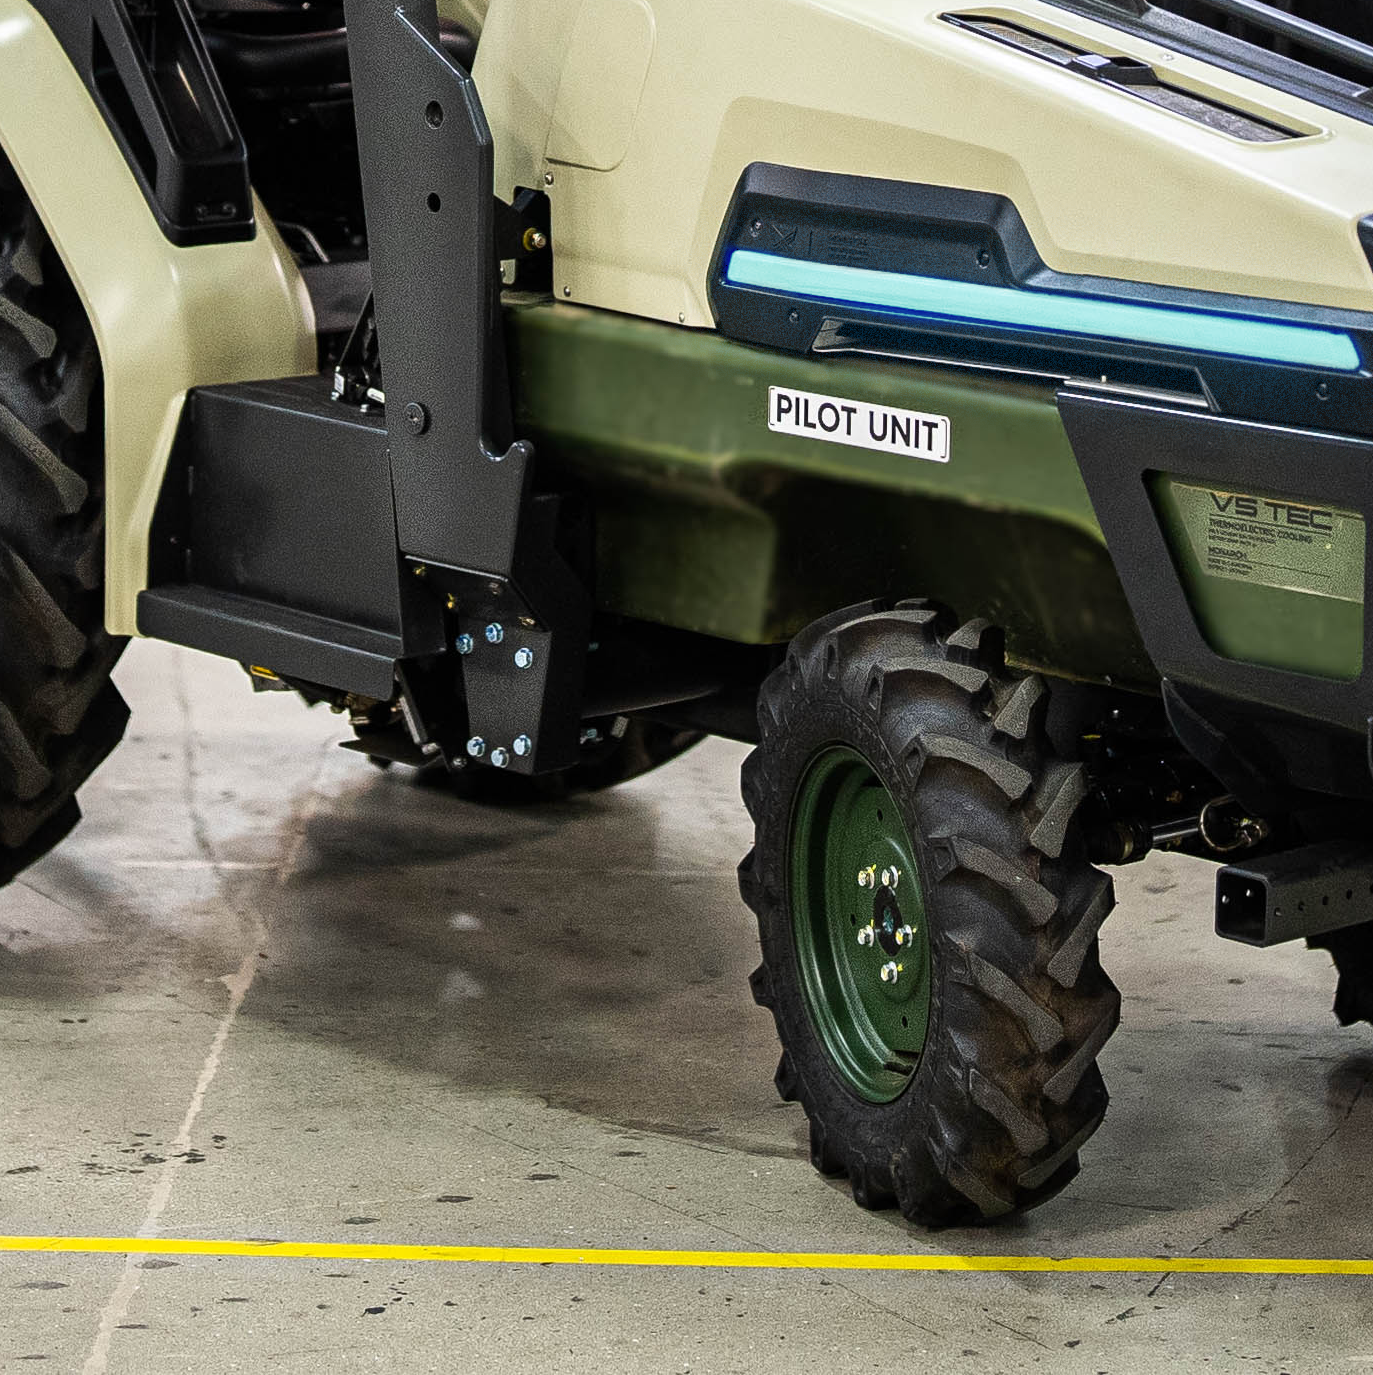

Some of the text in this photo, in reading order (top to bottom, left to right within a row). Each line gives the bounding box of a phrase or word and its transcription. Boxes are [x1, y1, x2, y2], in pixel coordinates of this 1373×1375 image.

[776, 392, 939, 452] PILOT UNIT
[1263, 500, 1333, 532] TEC
[1276, 529, 1313, 544] COOLING
